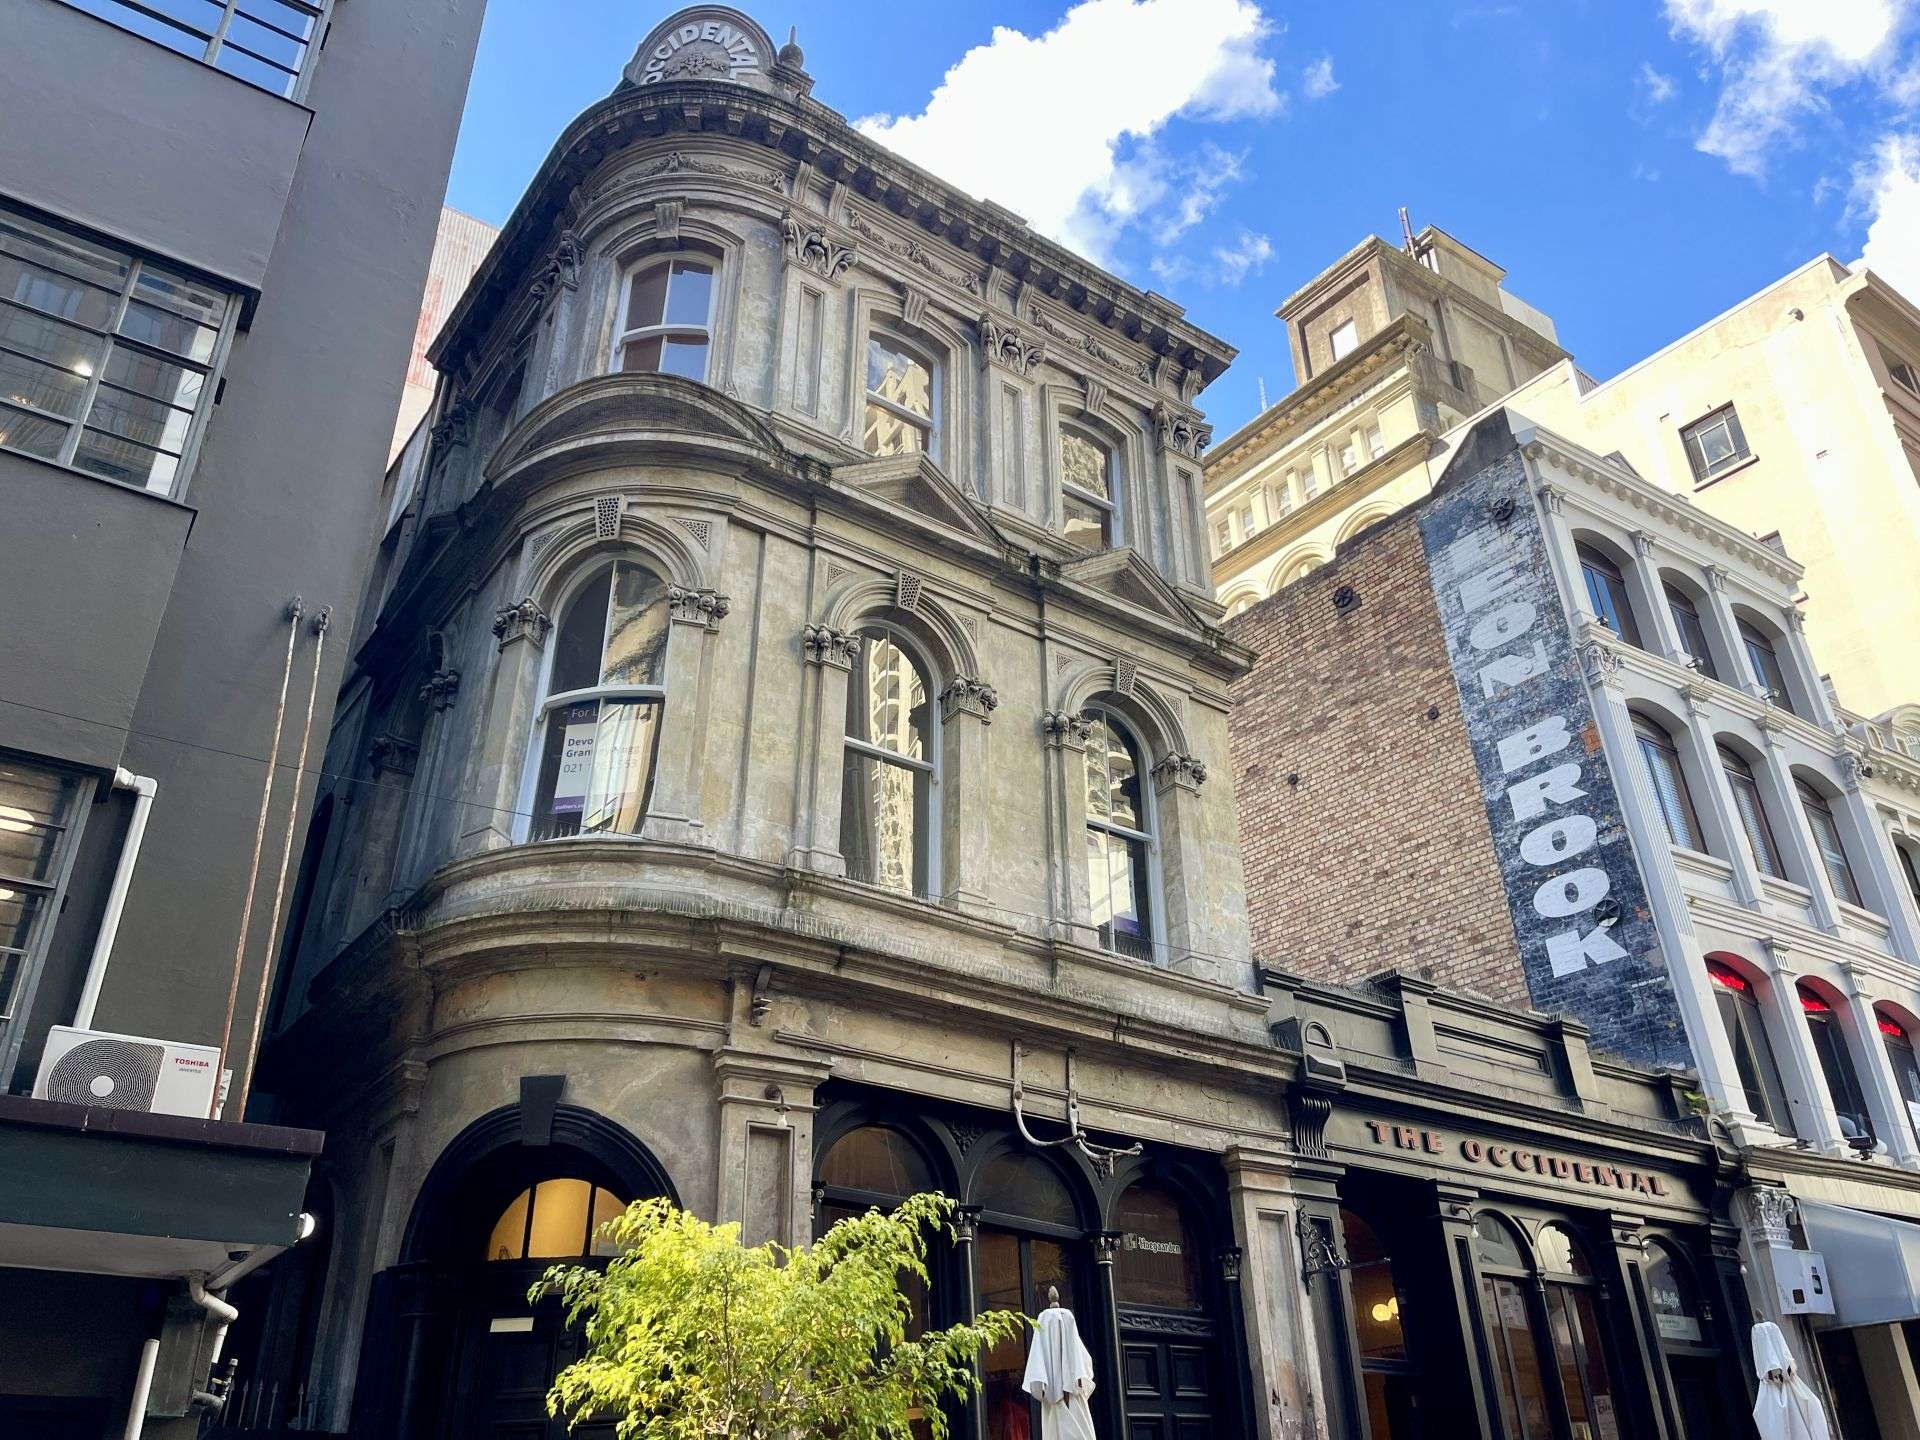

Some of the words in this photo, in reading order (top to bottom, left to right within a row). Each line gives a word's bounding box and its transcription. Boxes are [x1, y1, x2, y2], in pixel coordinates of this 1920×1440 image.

[640, 21, 761, 85] OCCIDENTAL
[571, 708, 591, 718] For
[568, 737, 594, 747] Devo
[566, 749, 591, 758] Gran
[563, 763, 582, 774] 021
[1495, 714, 1629, 979] BROOK
[175, 1058, 209, 1067] TOSHIBA
[1366, 1119, 1445, 1154] THE
[1461, 1138, 1670, 1197] OCCIDENTAL
